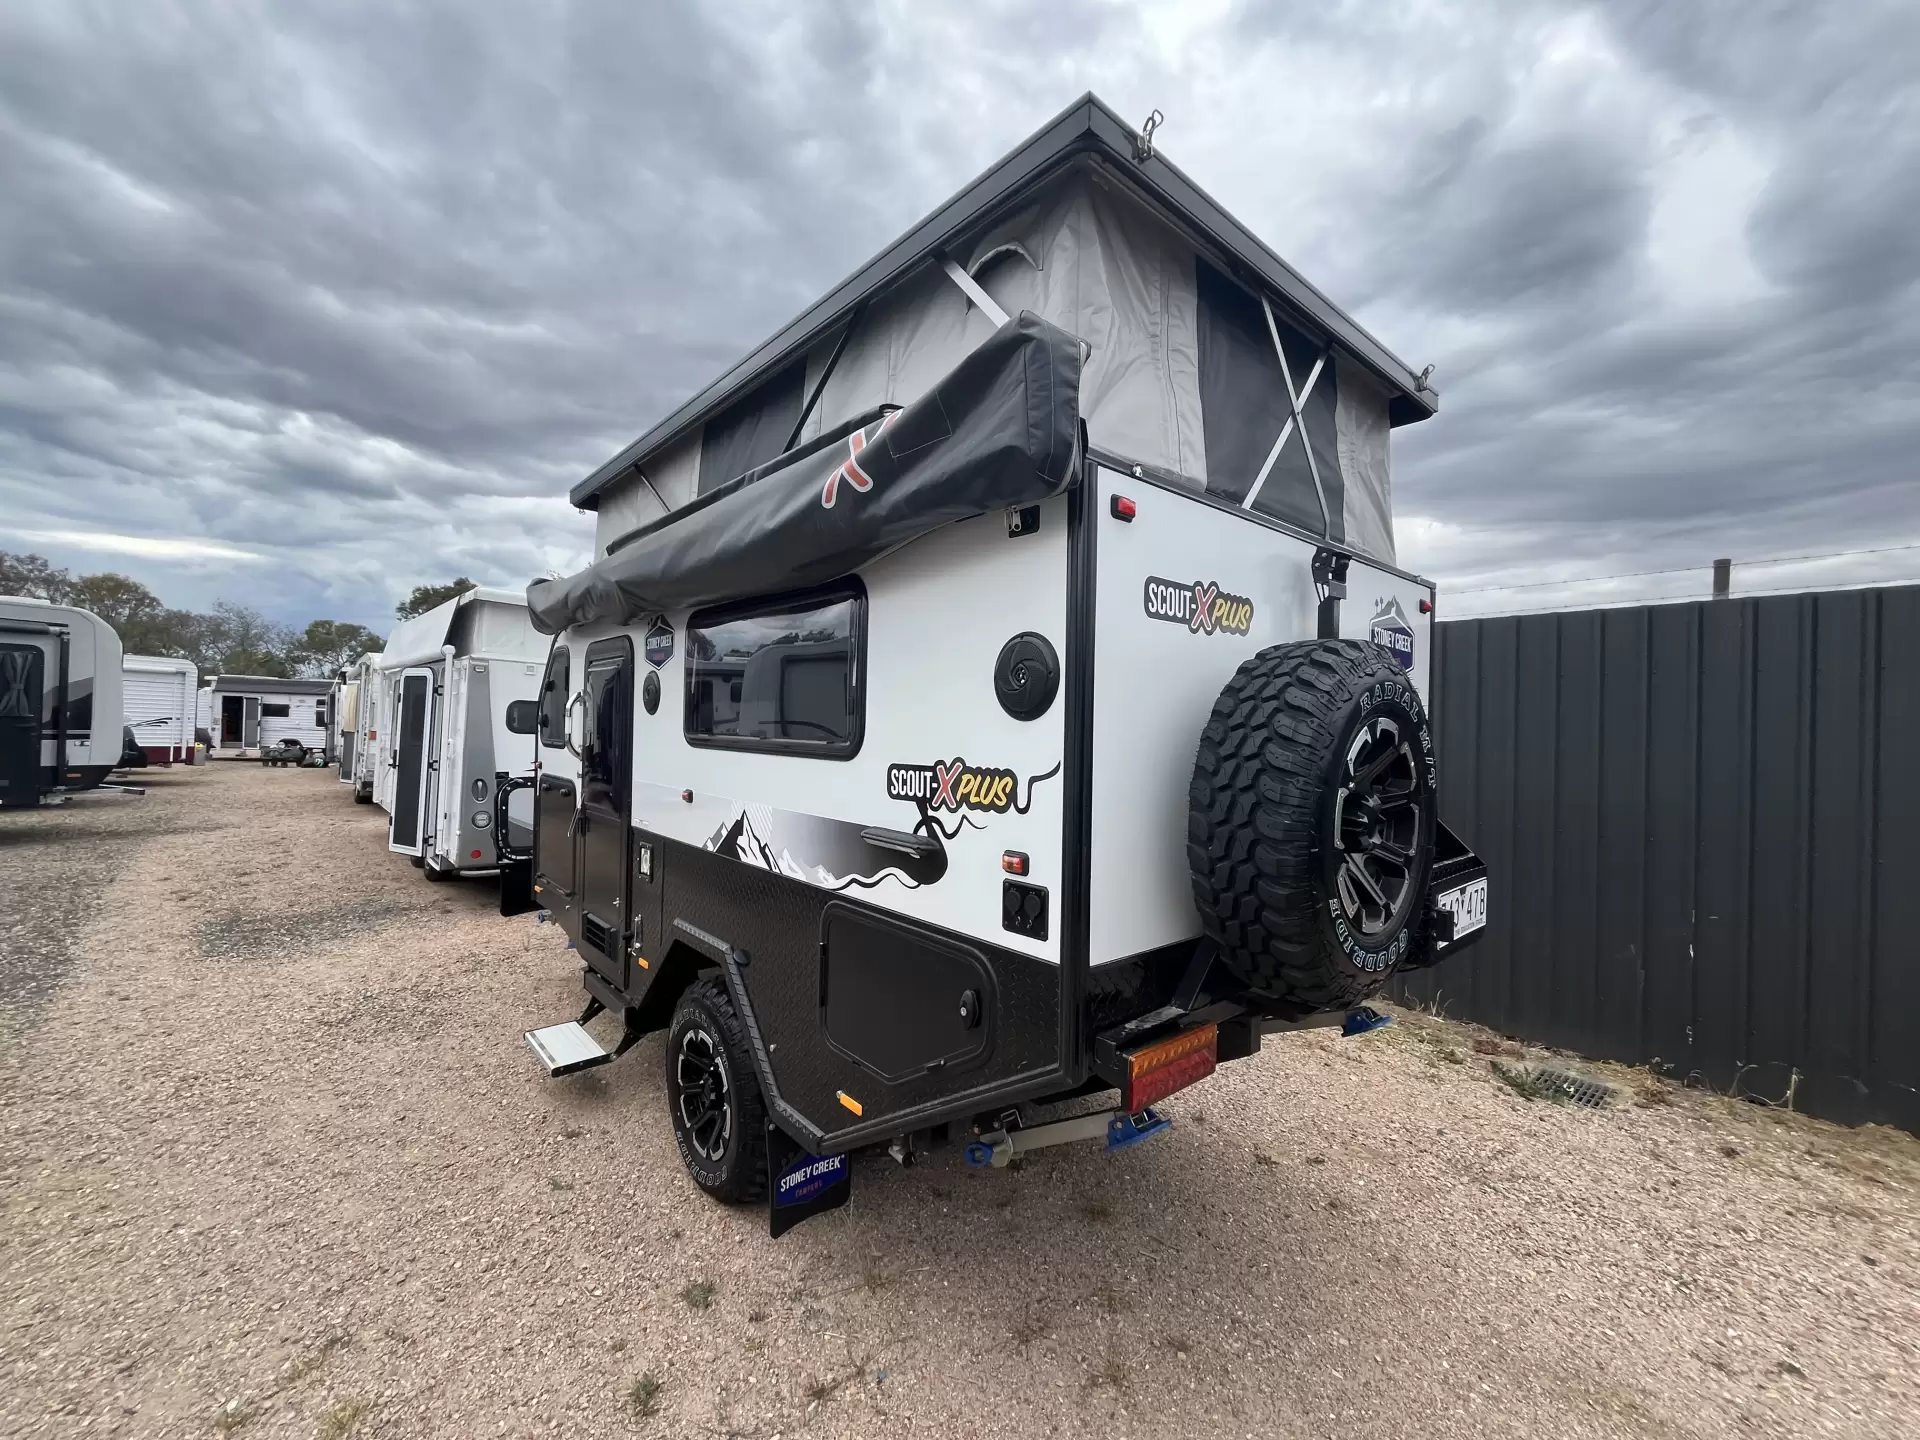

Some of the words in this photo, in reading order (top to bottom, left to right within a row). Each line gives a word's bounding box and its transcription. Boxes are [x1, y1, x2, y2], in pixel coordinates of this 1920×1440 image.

[1147, 582, 1218, 631] SCOUT-X
[1211, 598, 1251, 630] PLUS
[1373, 626, 1395, 649] STONEY
[1395, 632, 1413, 653] CREEK
[1360, 681, 1419, 723] RADIAL
[890, 762, 963, 809] SCOUT-X
[956, 773, 1014, 807] PLUS
[1328, 898, 1409, 972] GOODRIDE
[780, 1164, 813, 1193] STONEY
[812, 1155, 841, 1176] CREEK
